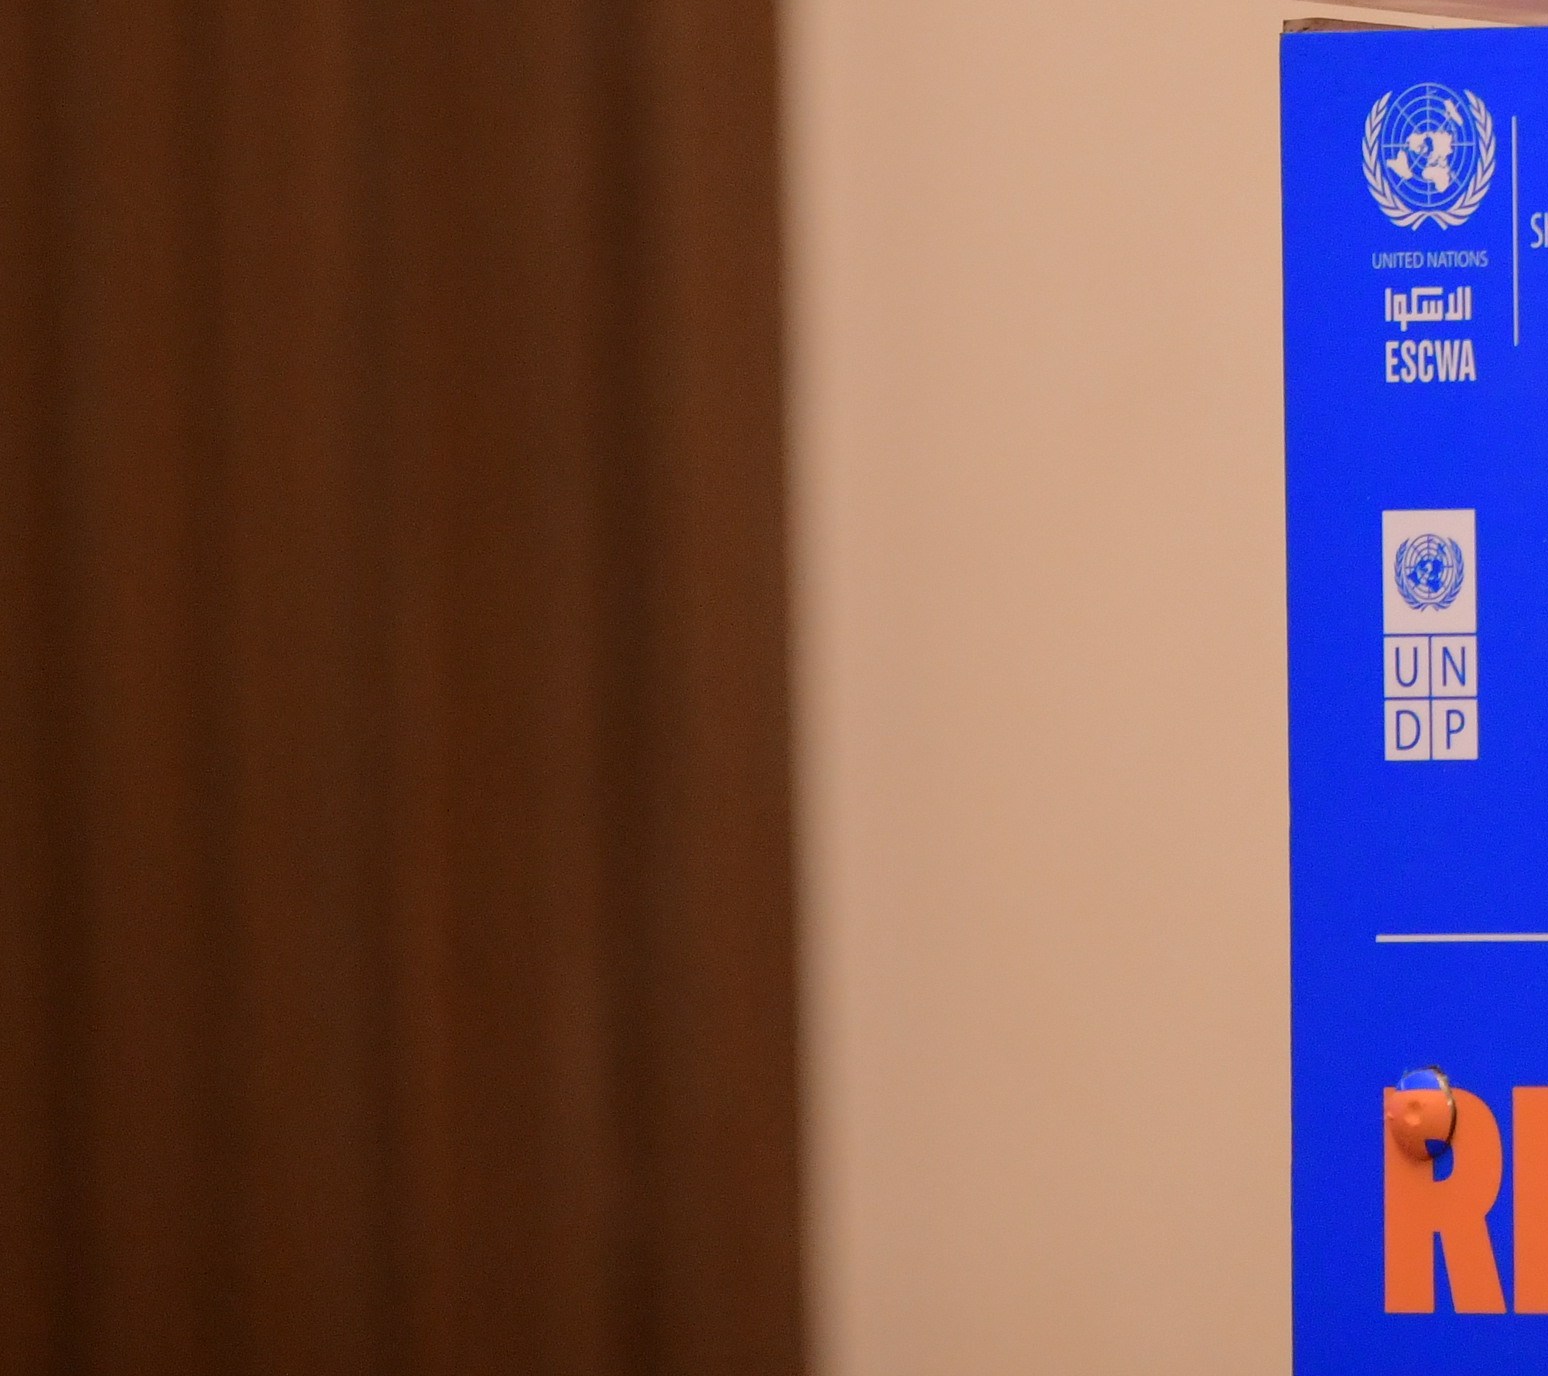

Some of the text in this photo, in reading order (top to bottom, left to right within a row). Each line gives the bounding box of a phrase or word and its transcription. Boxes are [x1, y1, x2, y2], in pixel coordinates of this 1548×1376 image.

[1371, 250, 1490, 270] UNITED NATIONS
[1385, 338, 1478, 384] ESCWA
